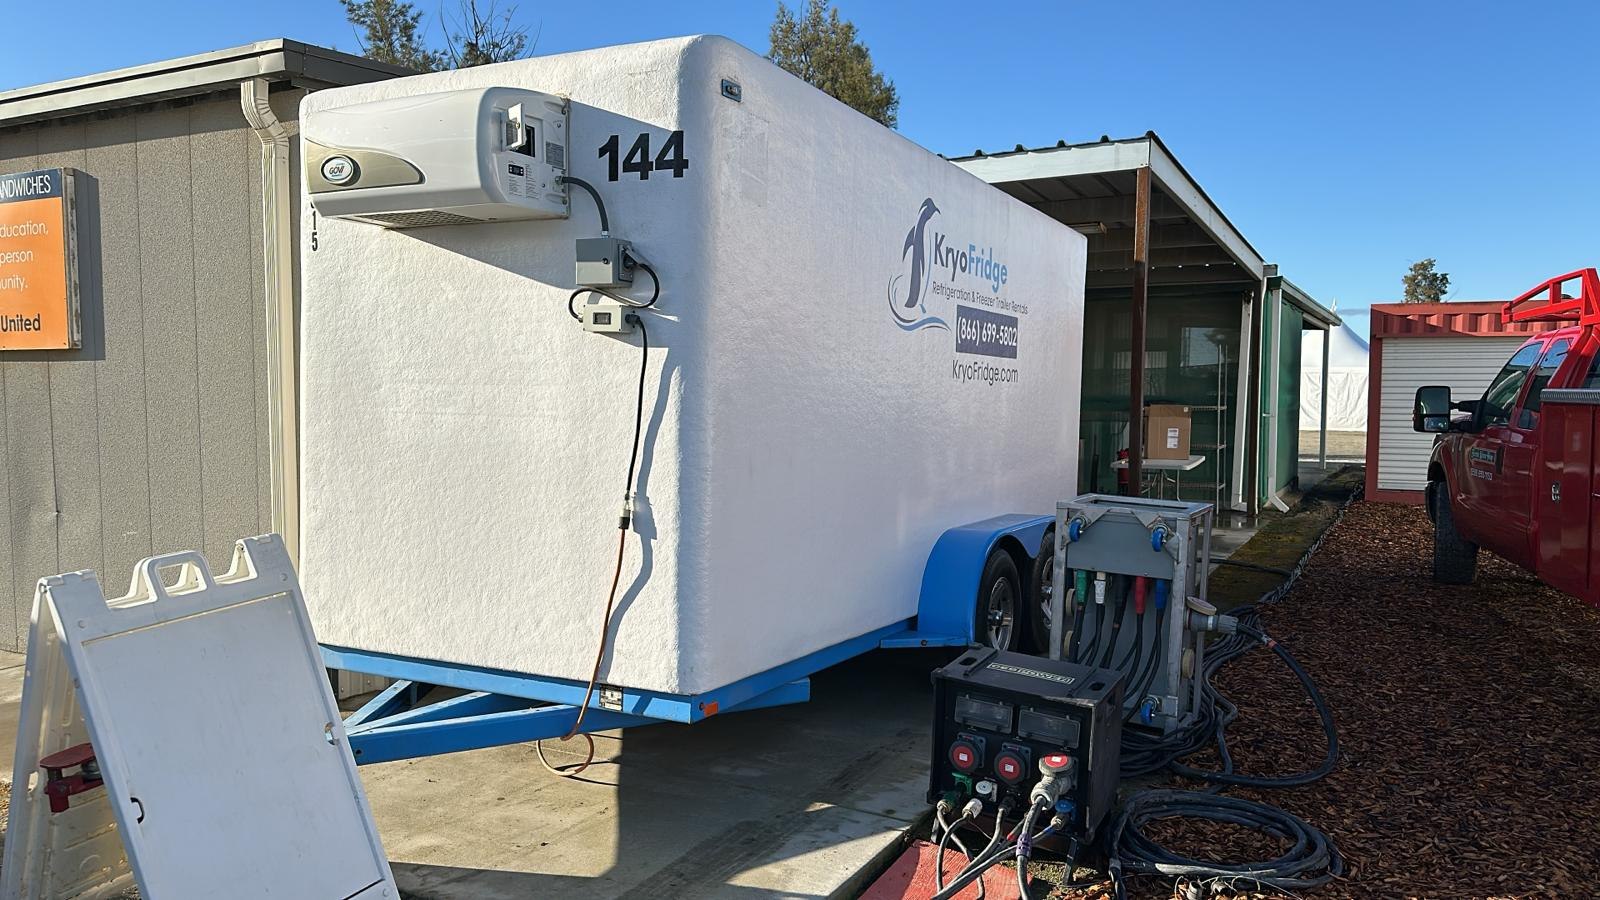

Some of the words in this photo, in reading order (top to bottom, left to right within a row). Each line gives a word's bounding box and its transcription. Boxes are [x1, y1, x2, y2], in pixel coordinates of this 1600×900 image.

[598, 130, 689, 182] 144
[310, 202, 318, 251] 15
[0, 250, 34, 267] person
[934, 232, 1008, 293] KryoFridge
[0, 274, 28, 292] unity.
[932, 281, 971, 302] Refrigeration
[971, 291, 975, 303] &
[976, 292, 996, 307] Freezer
[995, 297, 1011, 311] Trailer
[1010, 301, 1028, 315] Rentals
[0, 313, 41, 332] United
[957, 316, 980, 346] (866)
[982, 322, 1017, 347] 699-5802
[952, 359, 1019, 386] KryoFridge.com
